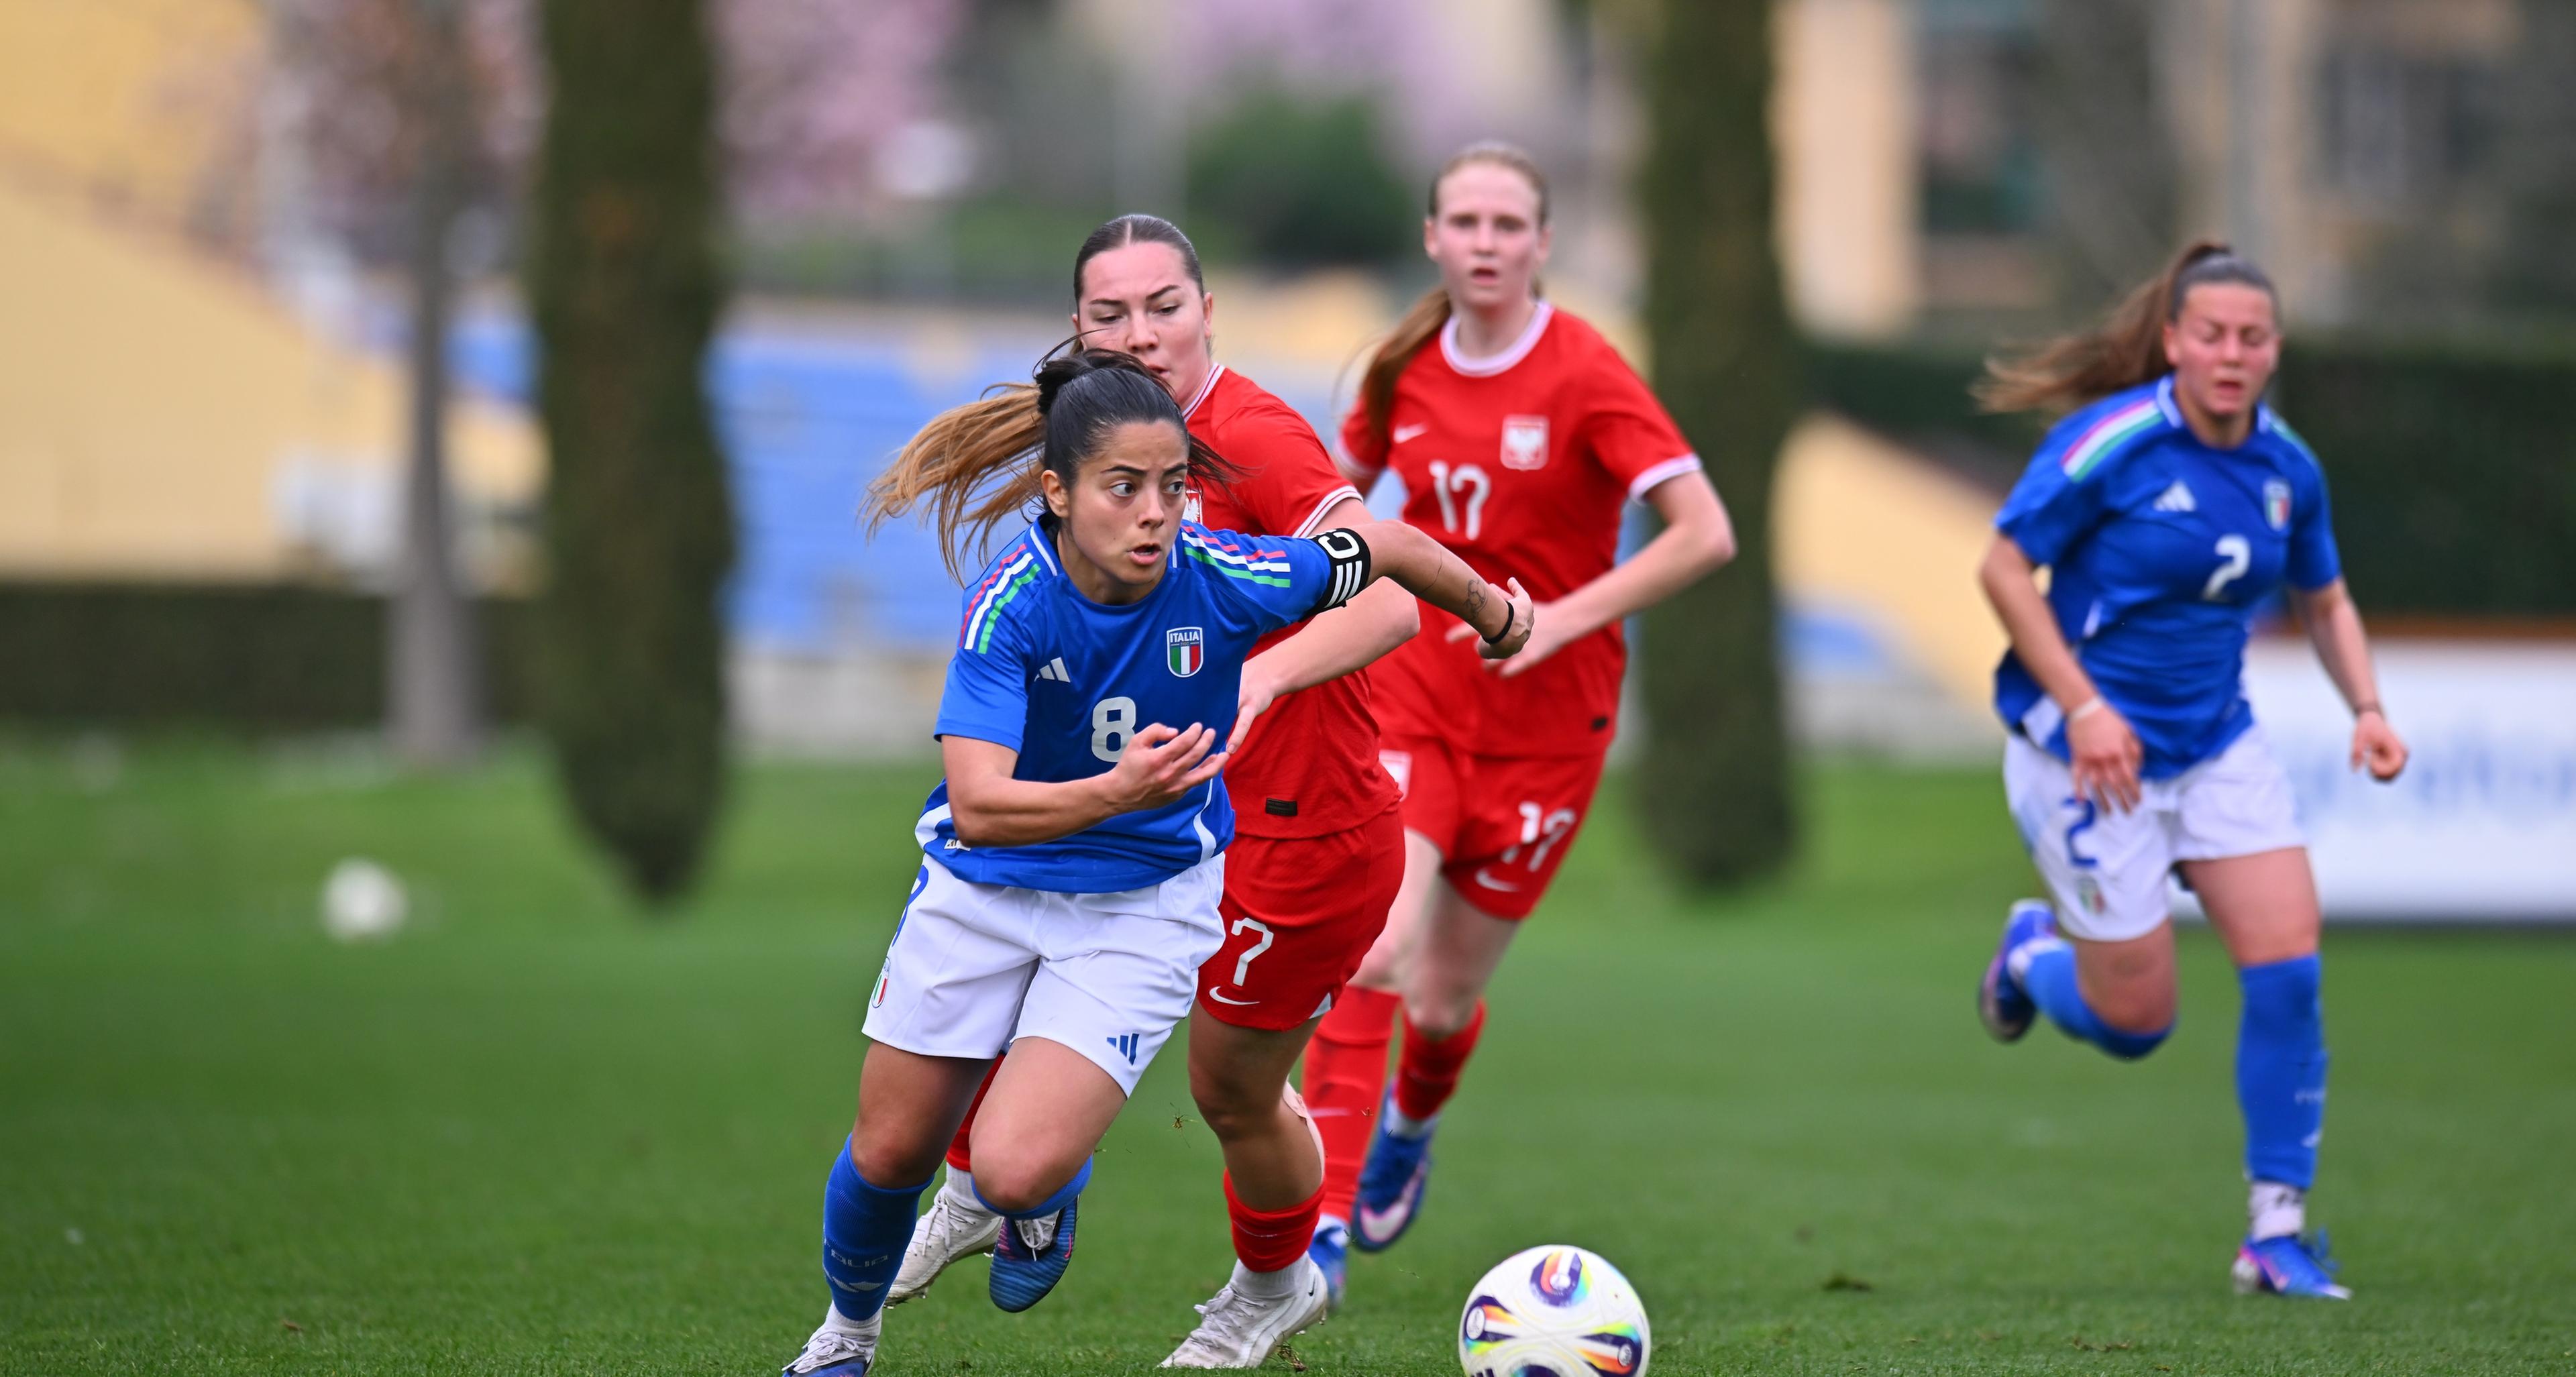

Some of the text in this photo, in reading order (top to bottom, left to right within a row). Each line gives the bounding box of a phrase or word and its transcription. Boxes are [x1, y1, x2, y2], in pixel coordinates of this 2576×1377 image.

[1429, 460, 1491, 541] 17
[1318, 531, 1360, 559] C
[2201, 534, 2250, 602] 2
[1170, 631, 1199, 643] ITALIA
[1091, 696, 1136, 763] 8
[2062, 797, 2098, 867] 2
[1231, 918, 1274, 987] 7
